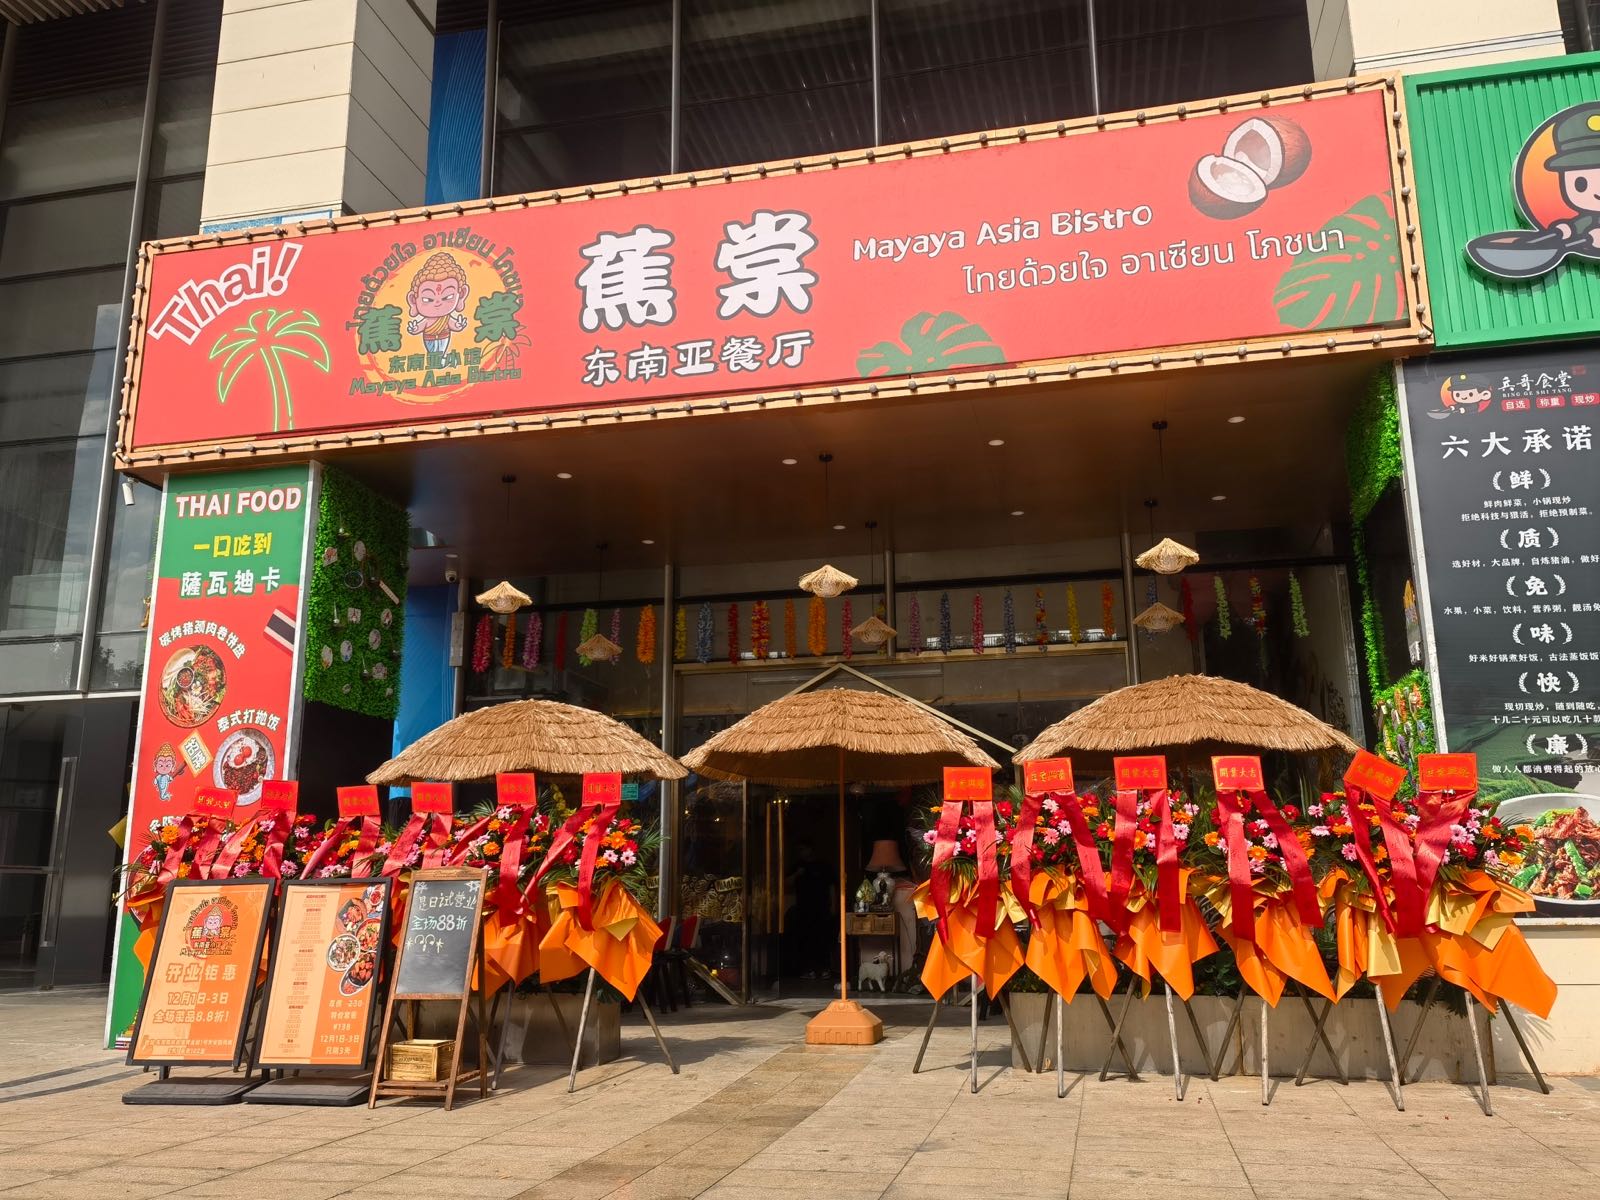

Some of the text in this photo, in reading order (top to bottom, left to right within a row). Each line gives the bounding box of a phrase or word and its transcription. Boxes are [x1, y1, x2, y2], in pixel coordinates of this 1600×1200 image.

[853, 204, 1153, 262] Mayaya Asia Bistro
[961, 228, 1346, 294] ไทยด้วยใจ อาเซียน โภชนา
[147, 242, 304, 346] Thai!
[357, 304, 402, 355] 蕉
[581, 330, 815, 387] 东南亚餐厅
[348, 365, 522, 397] Mayaya Asia Bistro
[1497, 370, 1573, 392] 兵哥食堂
[1505, 400, 1526, 410] 自选
[1574, 394, 1595, 405] 现炒
[1441, 424, 1593, 459] 六大承诺
[1509, 470, 1534, 489] 鲜
[176, 487, 302, 518] THAI FOOD
[193, 532, 273, 558] 一口吃到
[1517, 527, 1541, 549] 质
[180, 566, 282, 597] 薩瓦迪卡
[1524, 575, 1549, 596] 免
[1529, 623, 1556, 644] 味
[1536, 672, 1562, 693] 快
[216, 708, 281, 733] 泰式打抛饭
[184, 736, 207, 771] 招牌
[1545, 733, 1569, 755] 廉
[410, 914, 468, 931] 全场88折
[168, 991, 229, 1006] 12月1日-3日
